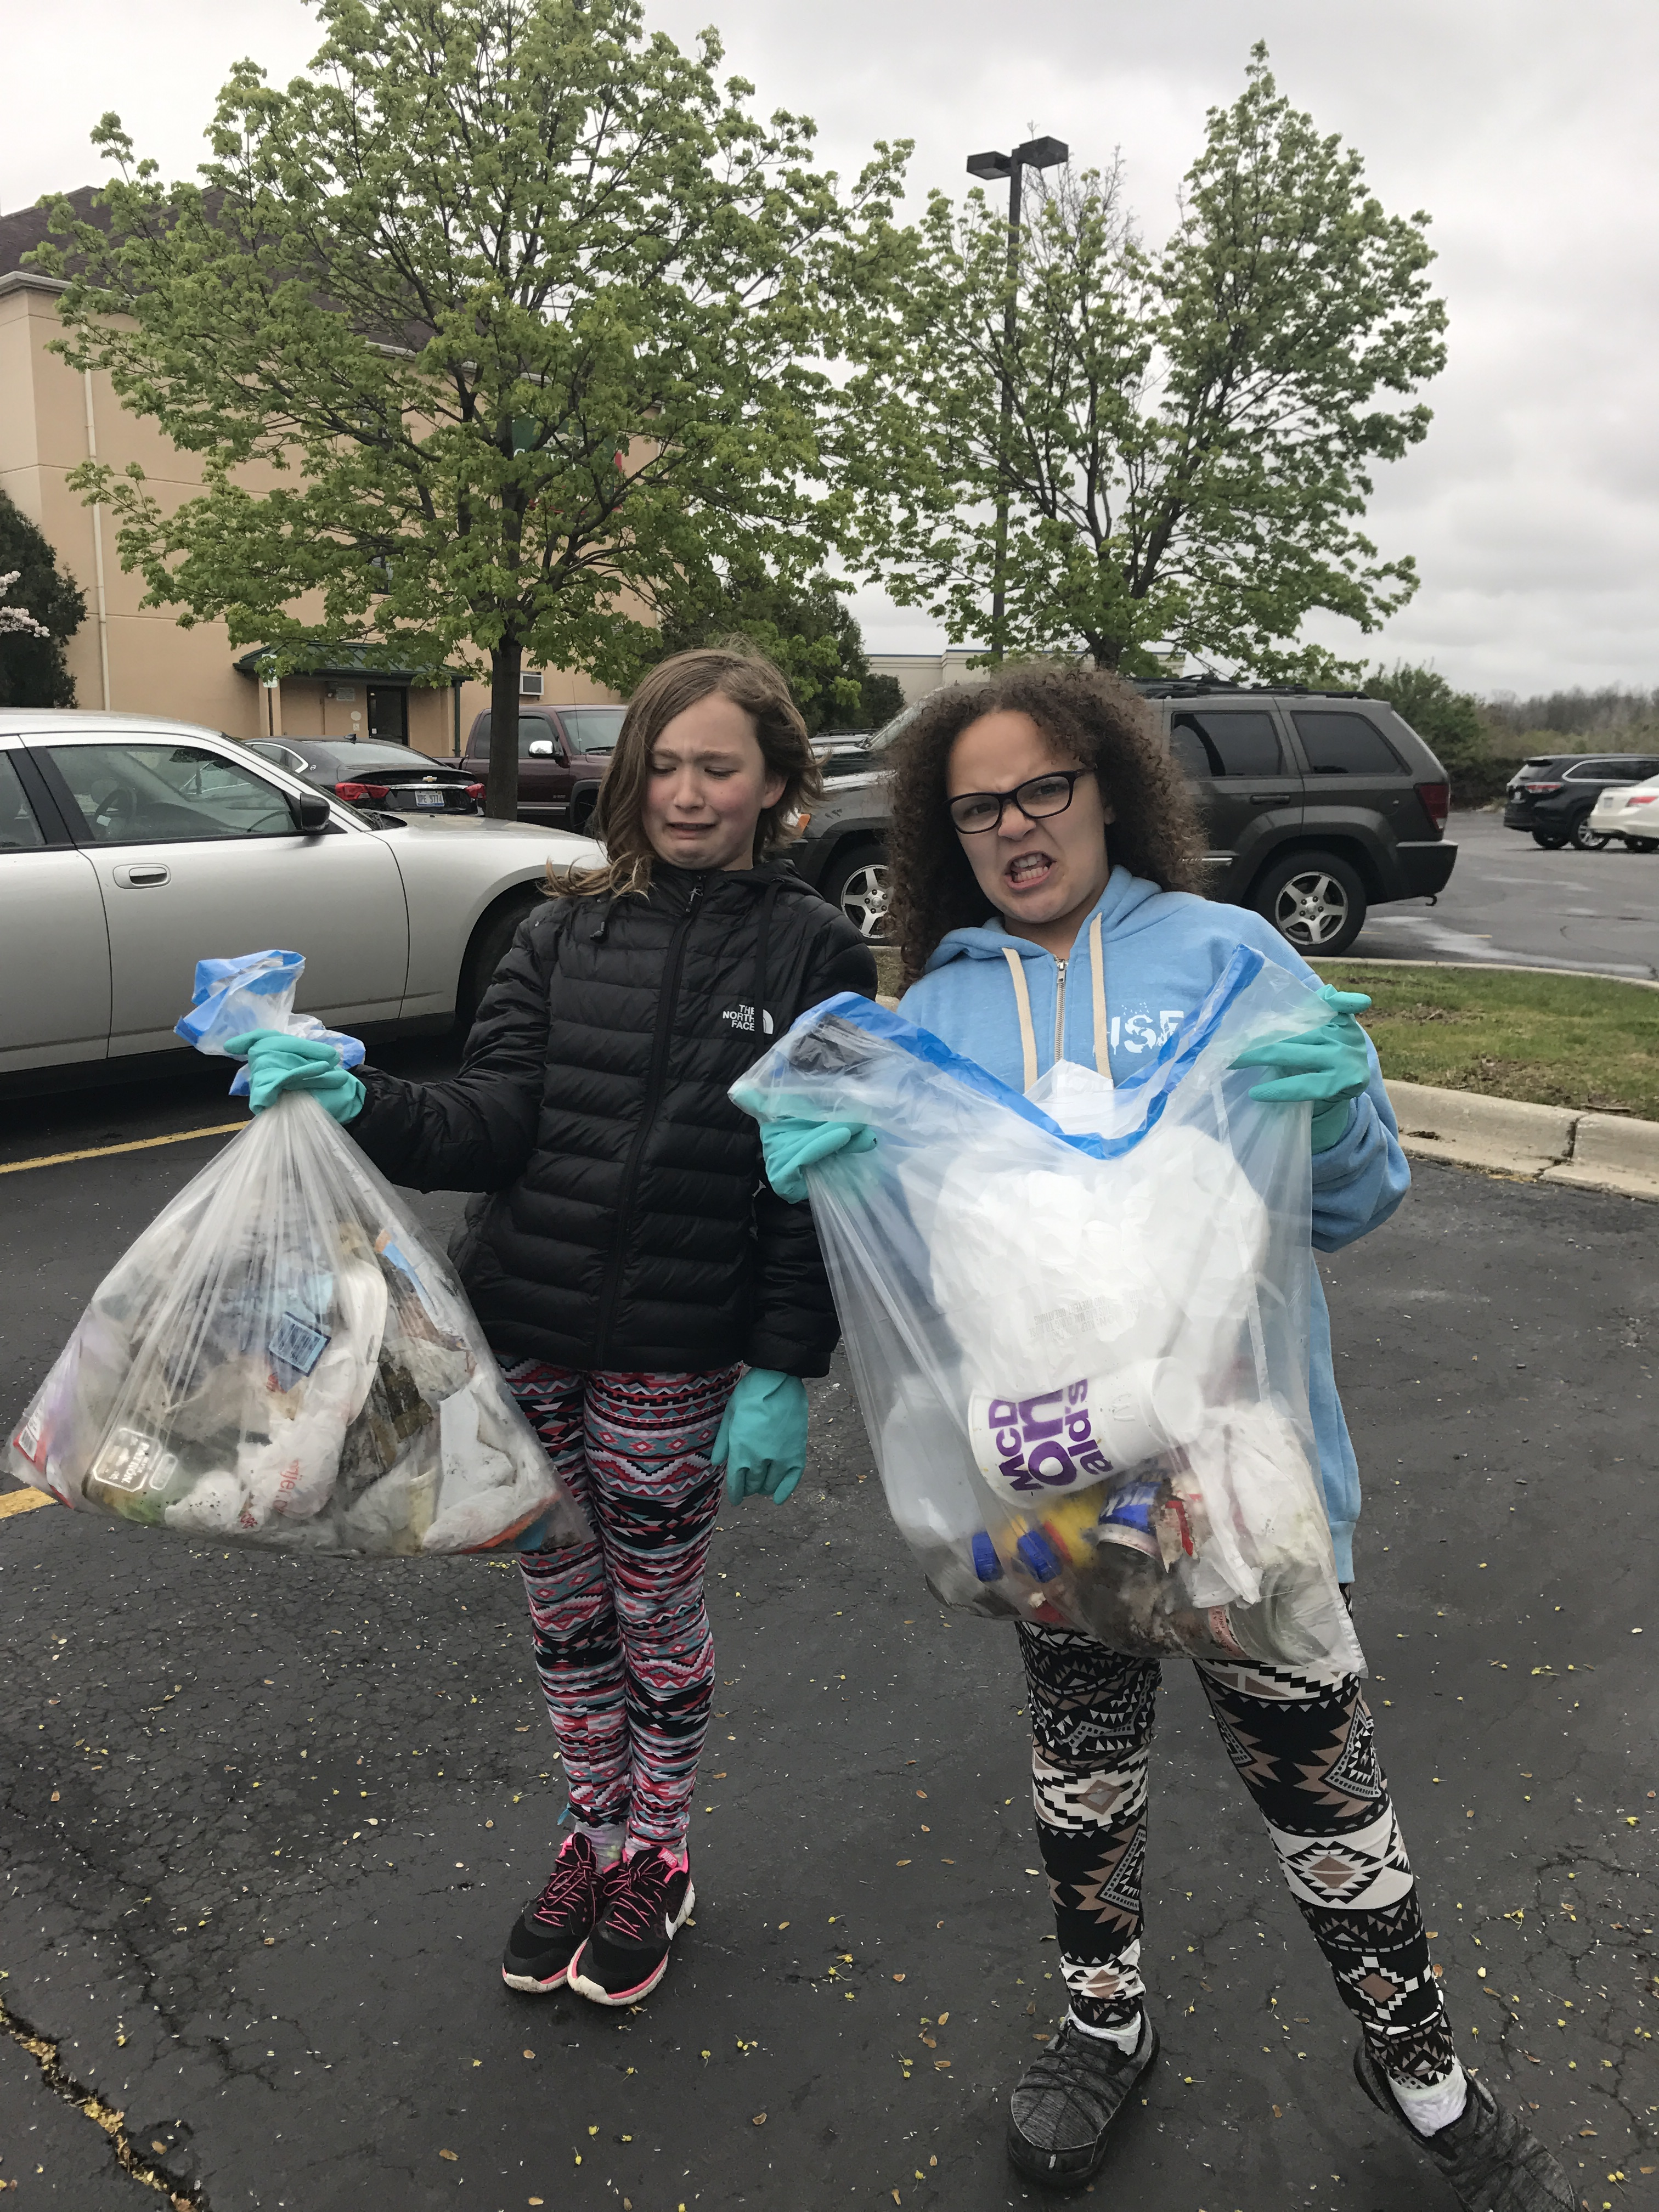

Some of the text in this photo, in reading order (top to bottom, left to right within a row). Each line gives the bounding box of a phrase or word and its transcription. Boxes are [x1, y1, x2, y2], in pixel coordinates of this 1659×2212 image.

[739, 1004, 755, 1015] THE
[723, 1011, 755, 1023] NORTH
[731, 1019, 755, 1031] FACE
[660, 1850, 677, 1866] NIKE
